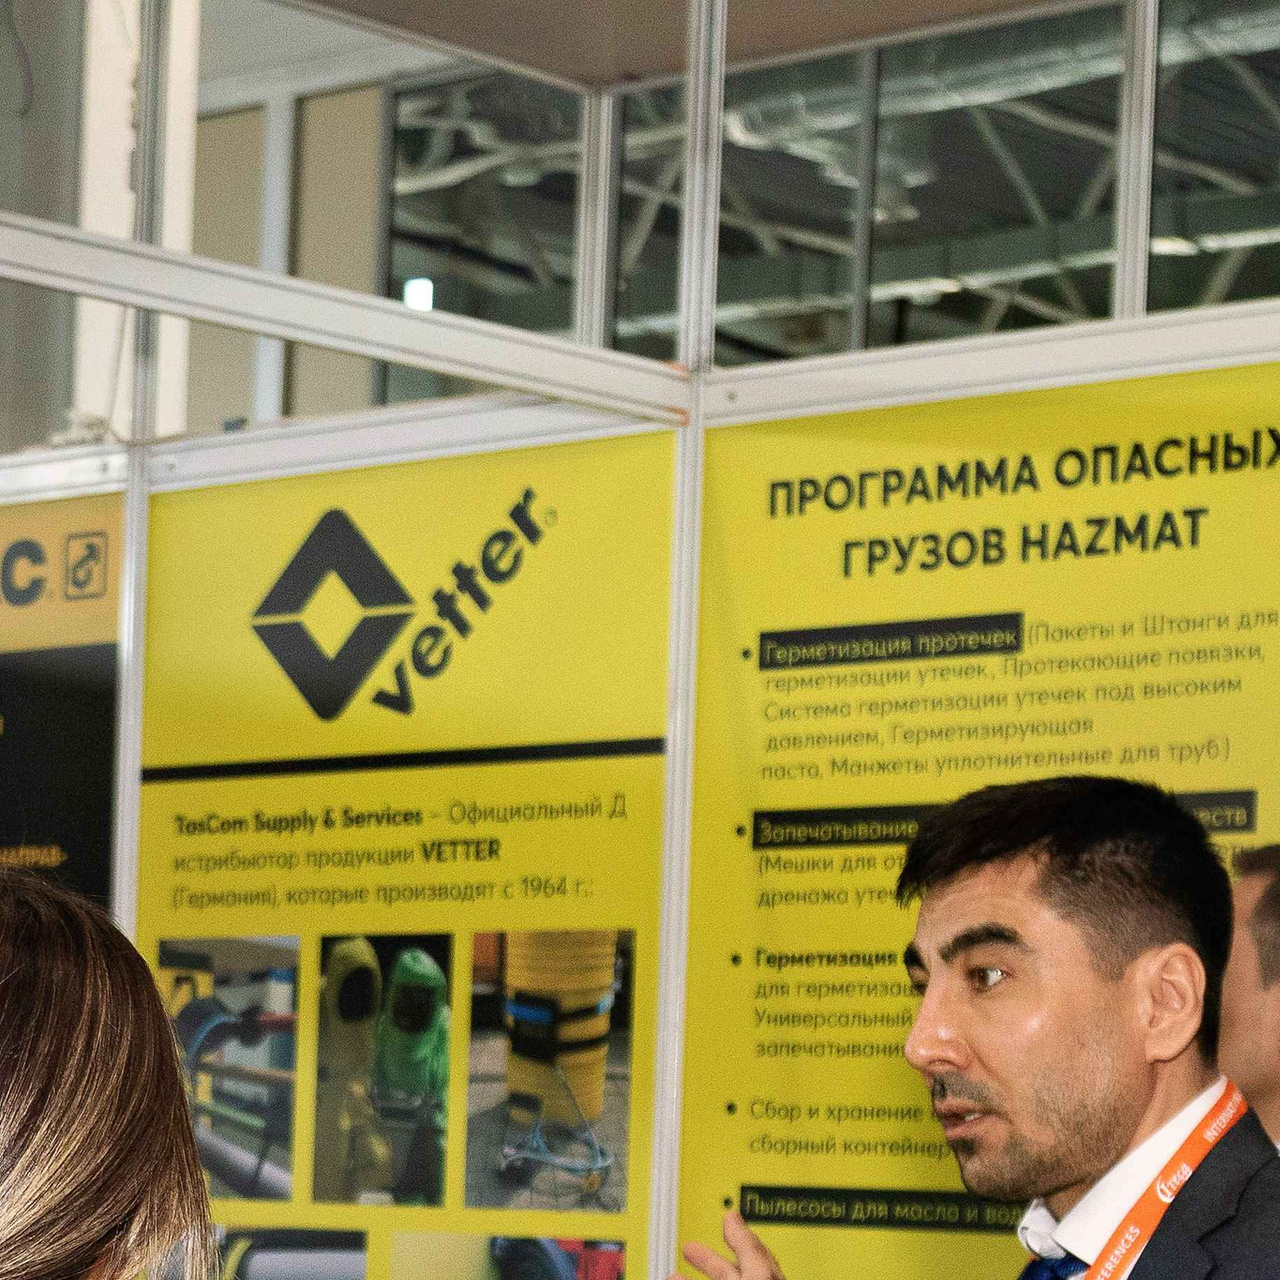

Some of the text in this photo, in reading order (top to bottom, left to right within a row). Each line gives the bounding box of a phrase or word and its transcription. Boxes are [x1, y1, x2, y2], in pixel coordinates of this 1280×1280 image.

[769, 454, 1041, 518] ПРОГРАММА
[843, 506, 1209, 578] ГРУЗОВ HAZMAT
[421, 837, 501, 863] VETTER
[842, 1137, 950, 1161] контейнер
